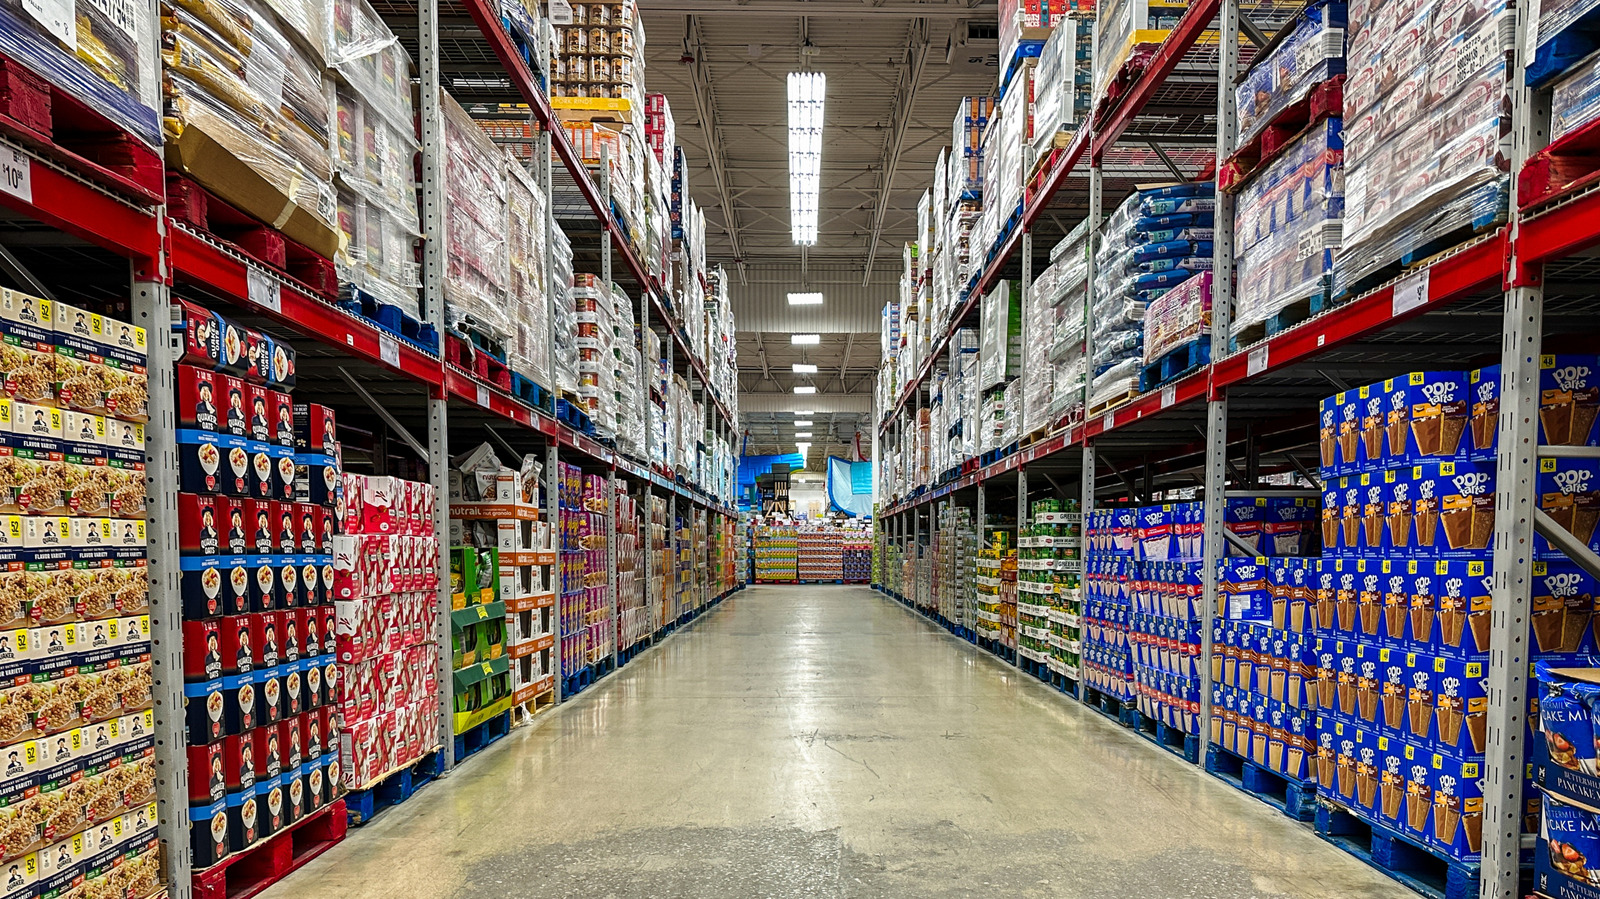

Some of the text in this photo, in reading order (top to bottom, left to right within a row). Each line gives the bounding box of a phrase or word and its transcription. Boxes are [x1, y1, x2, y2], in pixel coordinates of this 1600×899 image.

[42, 305, 49, 316] 52
[19, 313, 38, 324] QUAKER
[93, 319, 100, 329] 52
[73, 326, 90, 337] QUAKER
[137, 332, 144, 342] 52
[118, 339, 134, 348] QUAKER
[1, 406, 8, 417] 52
[52, 413, 60, 425] 52
[32, 425, 50, 434] QUAKER
[97, 421, 104, 432] 52
[137, 428, 142, 438] 52
[11, 521, 19, 533] 52
[61, 522, 68, 533] 52
[103, 523, 109, 533] 52
[138, 525, 144, 534] 52
[110, 624, 117, 634] 52
[142, 620, 148, 630] 52
[67, 629, 74, 640] 52
[18, 635, 26, 646] 52
[48, 646, 64, 654] QUAKER
[145, 713, 151, 724] 52
[1569, 710, 1588, 722] MI
[111, 723, 117, 733] 52
[73, 733, 80, 745] 52
[95, 740, 110, 749] QUAKER
[27, 747, 35, 759] 52
[55, 752, 71, 762] QUAKER
[5, 766, 25, 777] QUAKER
[1564, 771, 1600, 788] BUTTERMIL
[0, 786, 15, 796] LAVOR
[1557, 777, 1596, 800] PANCAKE
[115, 822, 121, 832] 52
[74, 838, 81, 850] 52
[27, 858, 35, 869] 52
[57, 859, 72, 869] QUAKER
[6, 880, 25, 891] QUAKER
